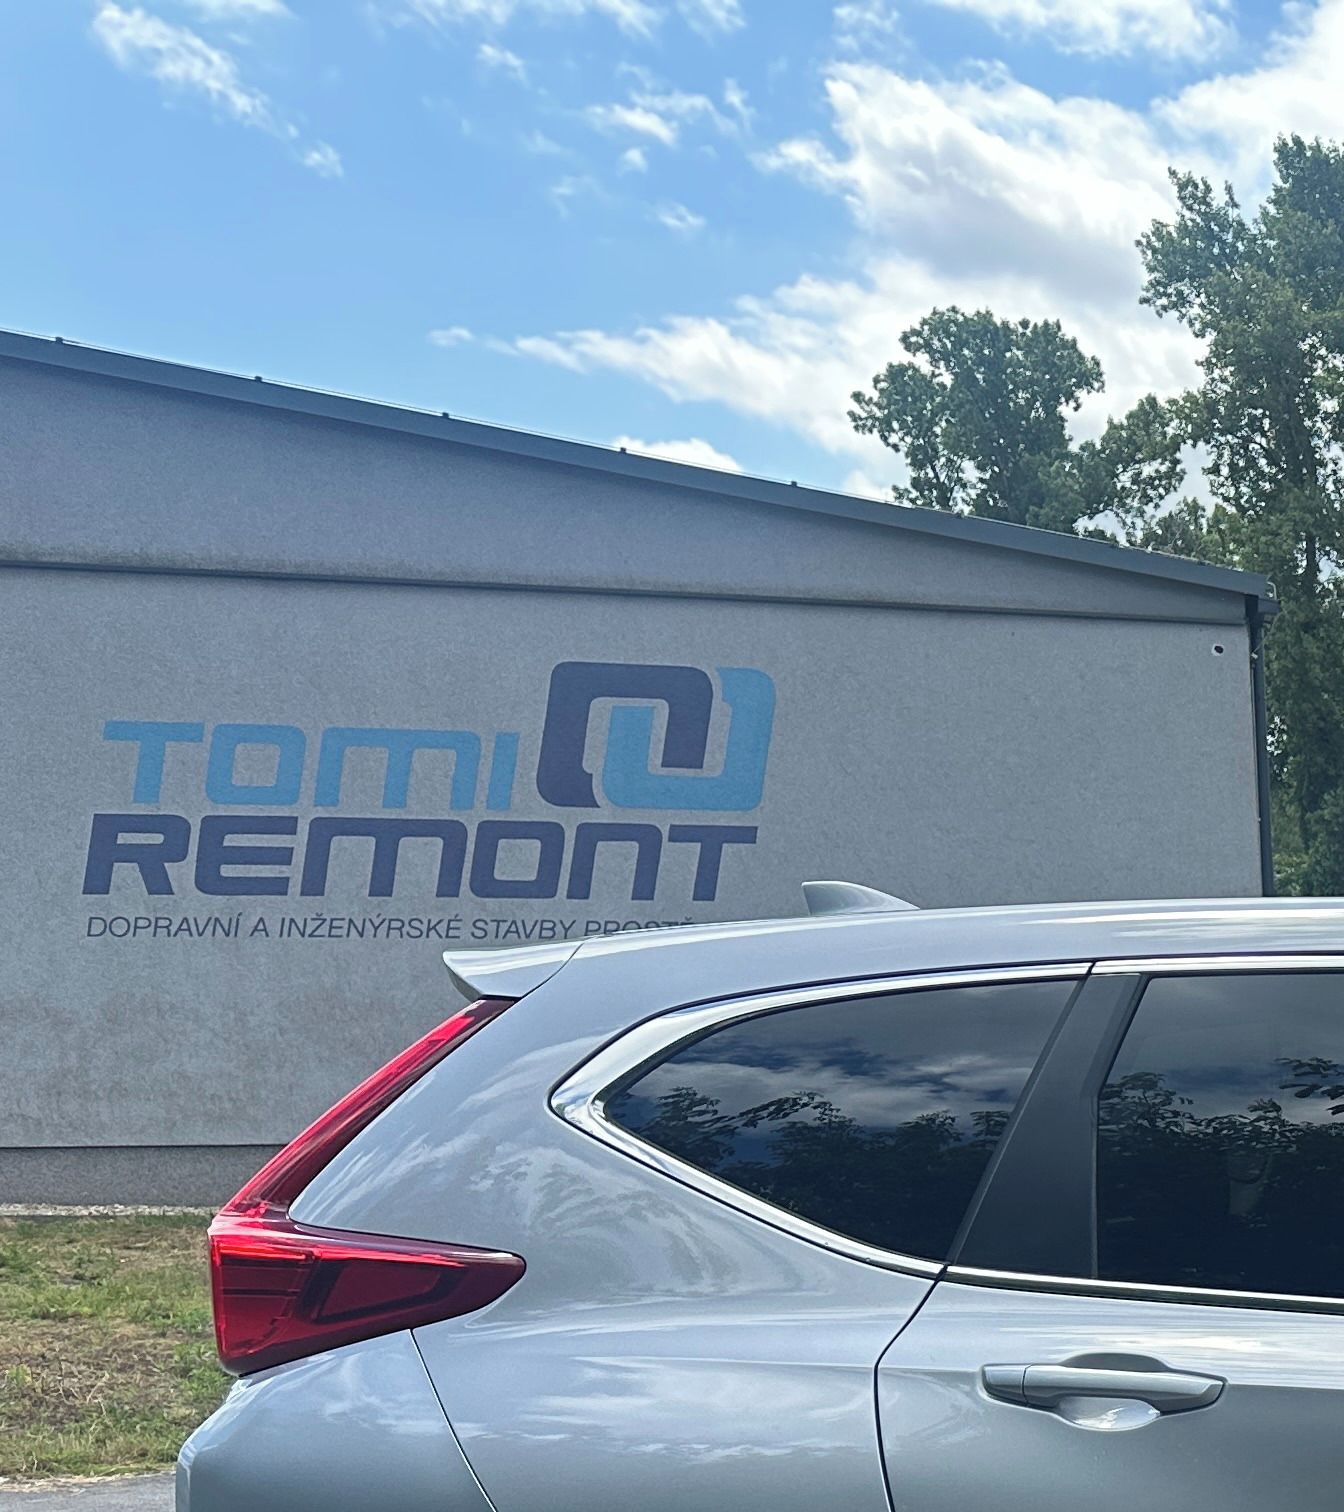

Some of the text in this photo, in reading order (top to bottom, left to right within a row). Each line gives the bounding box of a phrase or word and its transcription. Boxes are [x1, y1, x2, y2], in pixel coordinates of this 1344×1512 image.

[102, 720, 520, 812] TOMI
[81, 812, 759, 901] REMONT
[86, 912, 243, 938] DOPRAVNÍ
[250, 917, 270, 938] A
[278, 912, 463, 939] INŽENÝRSKÉ
[470, 918, 577, 940] STAVBY
